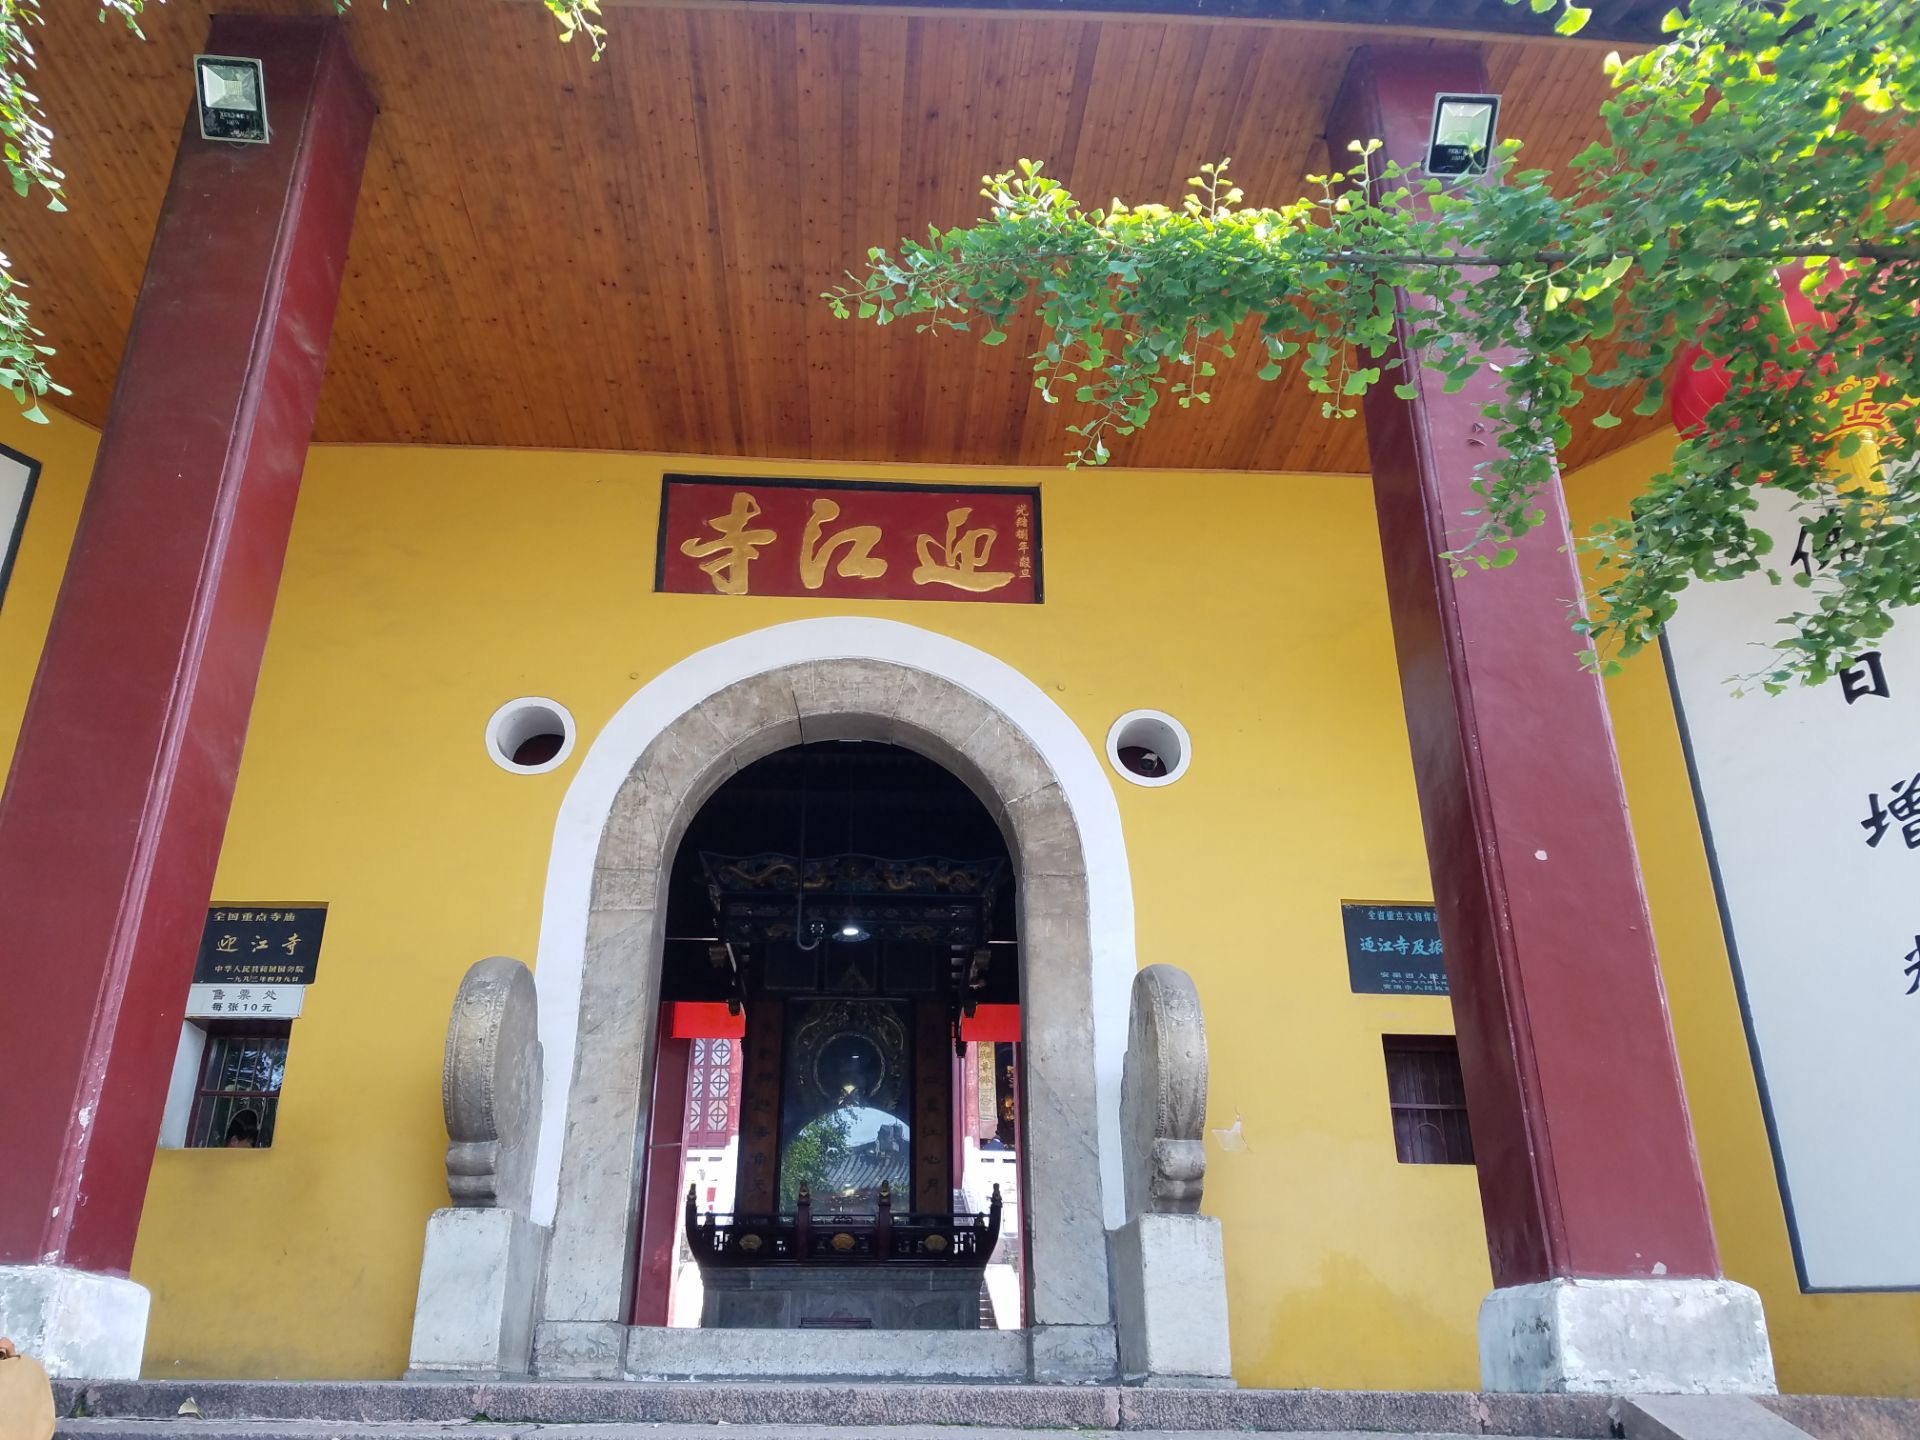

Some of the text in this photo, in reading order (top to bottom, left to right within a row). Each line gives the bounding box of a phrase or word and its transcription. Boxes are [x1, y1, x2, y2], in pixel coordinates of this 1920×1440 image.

[214, 911, 296, 922] 全国重点寺庙
[216, 933, 302, 956] 迎江寺
[211, 989, 278, 1001] 售票处
[211, 1002, 273, 1013] 每张10元
